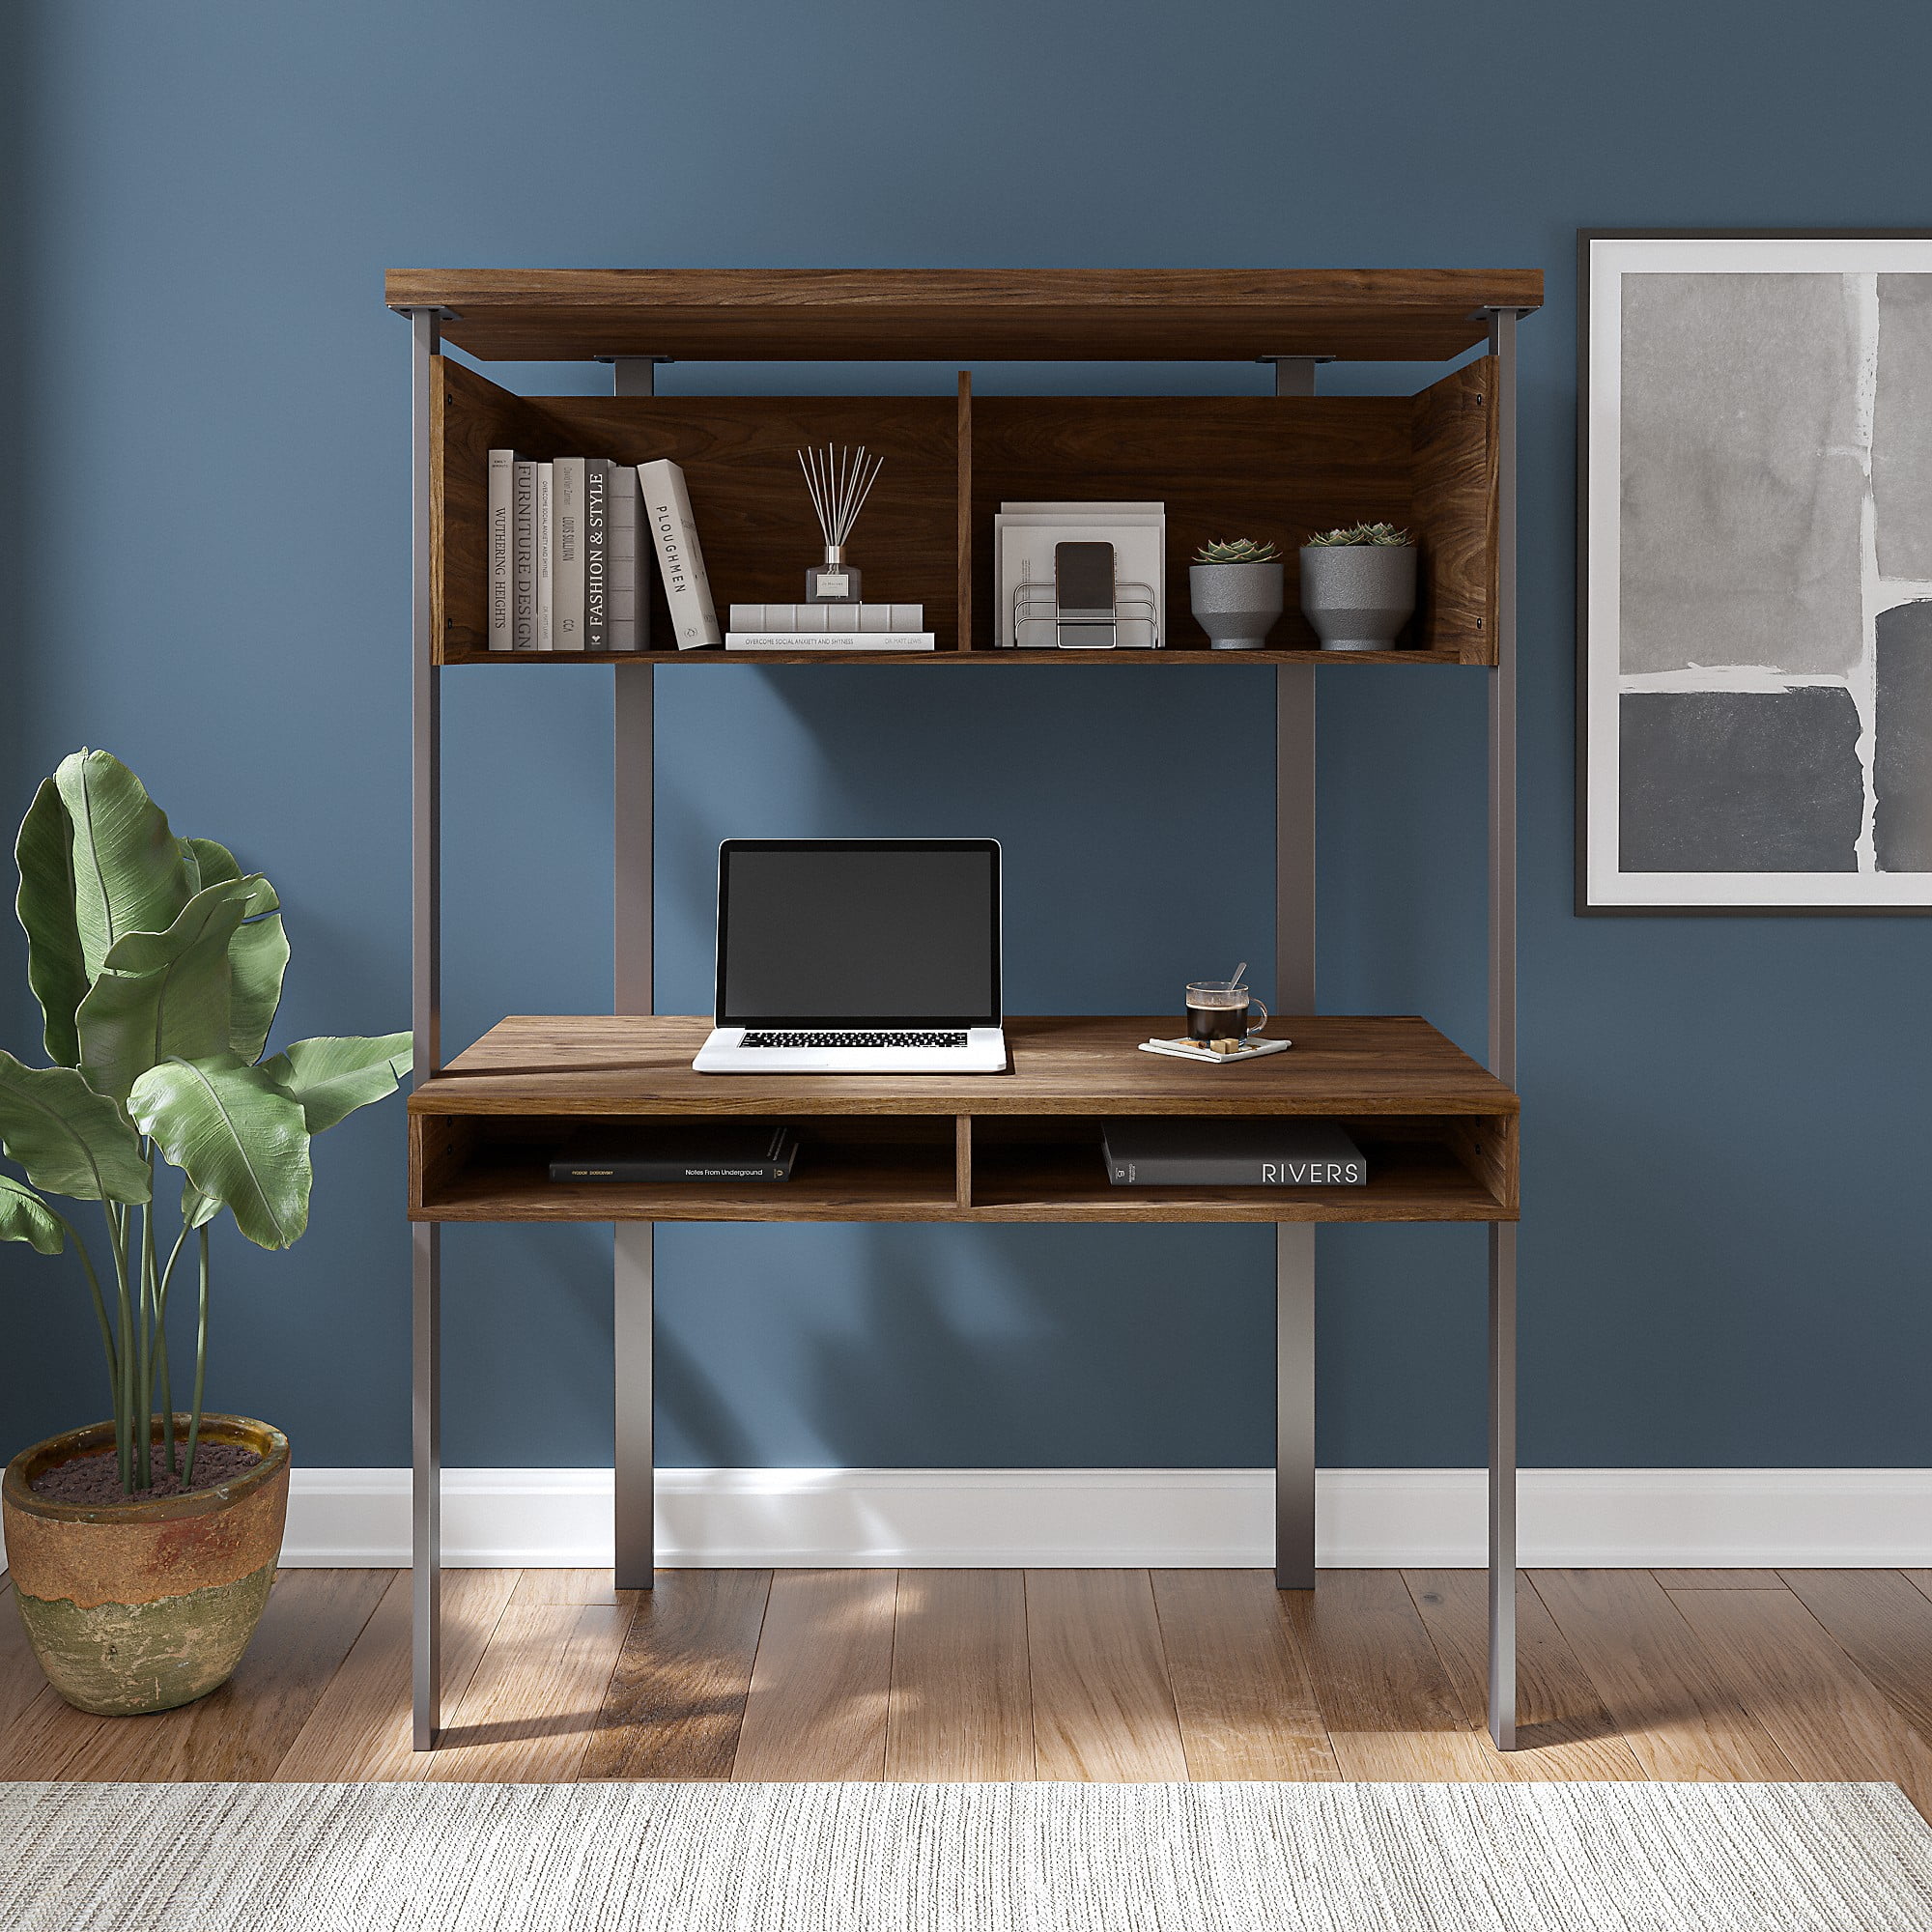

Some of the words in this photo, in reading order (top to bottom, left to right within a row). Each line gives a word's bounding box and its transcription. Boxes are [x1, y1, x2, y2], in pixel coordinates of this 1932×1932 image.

[518, 466, 530, 574] FURNITURE
[562, 517, 574, 532] LOUIS
[590, 473, 603, 526] STYLE
[495, 507, 505, 576] WUTHERING
[562, 533, 574, 561] SULLIVAN
[590, 531, 603, 544] &
[656, 505, 686, 592] PLOUGHMEN
[495, 582, 505, 629] HEIGHTS
[590, 550, 603, 626] FASHION
[518, 582, 530, 648] DESIGN
[563, 619, 574, 633] CCA
[1262, 1163, 1358, 1183] RIVERS
